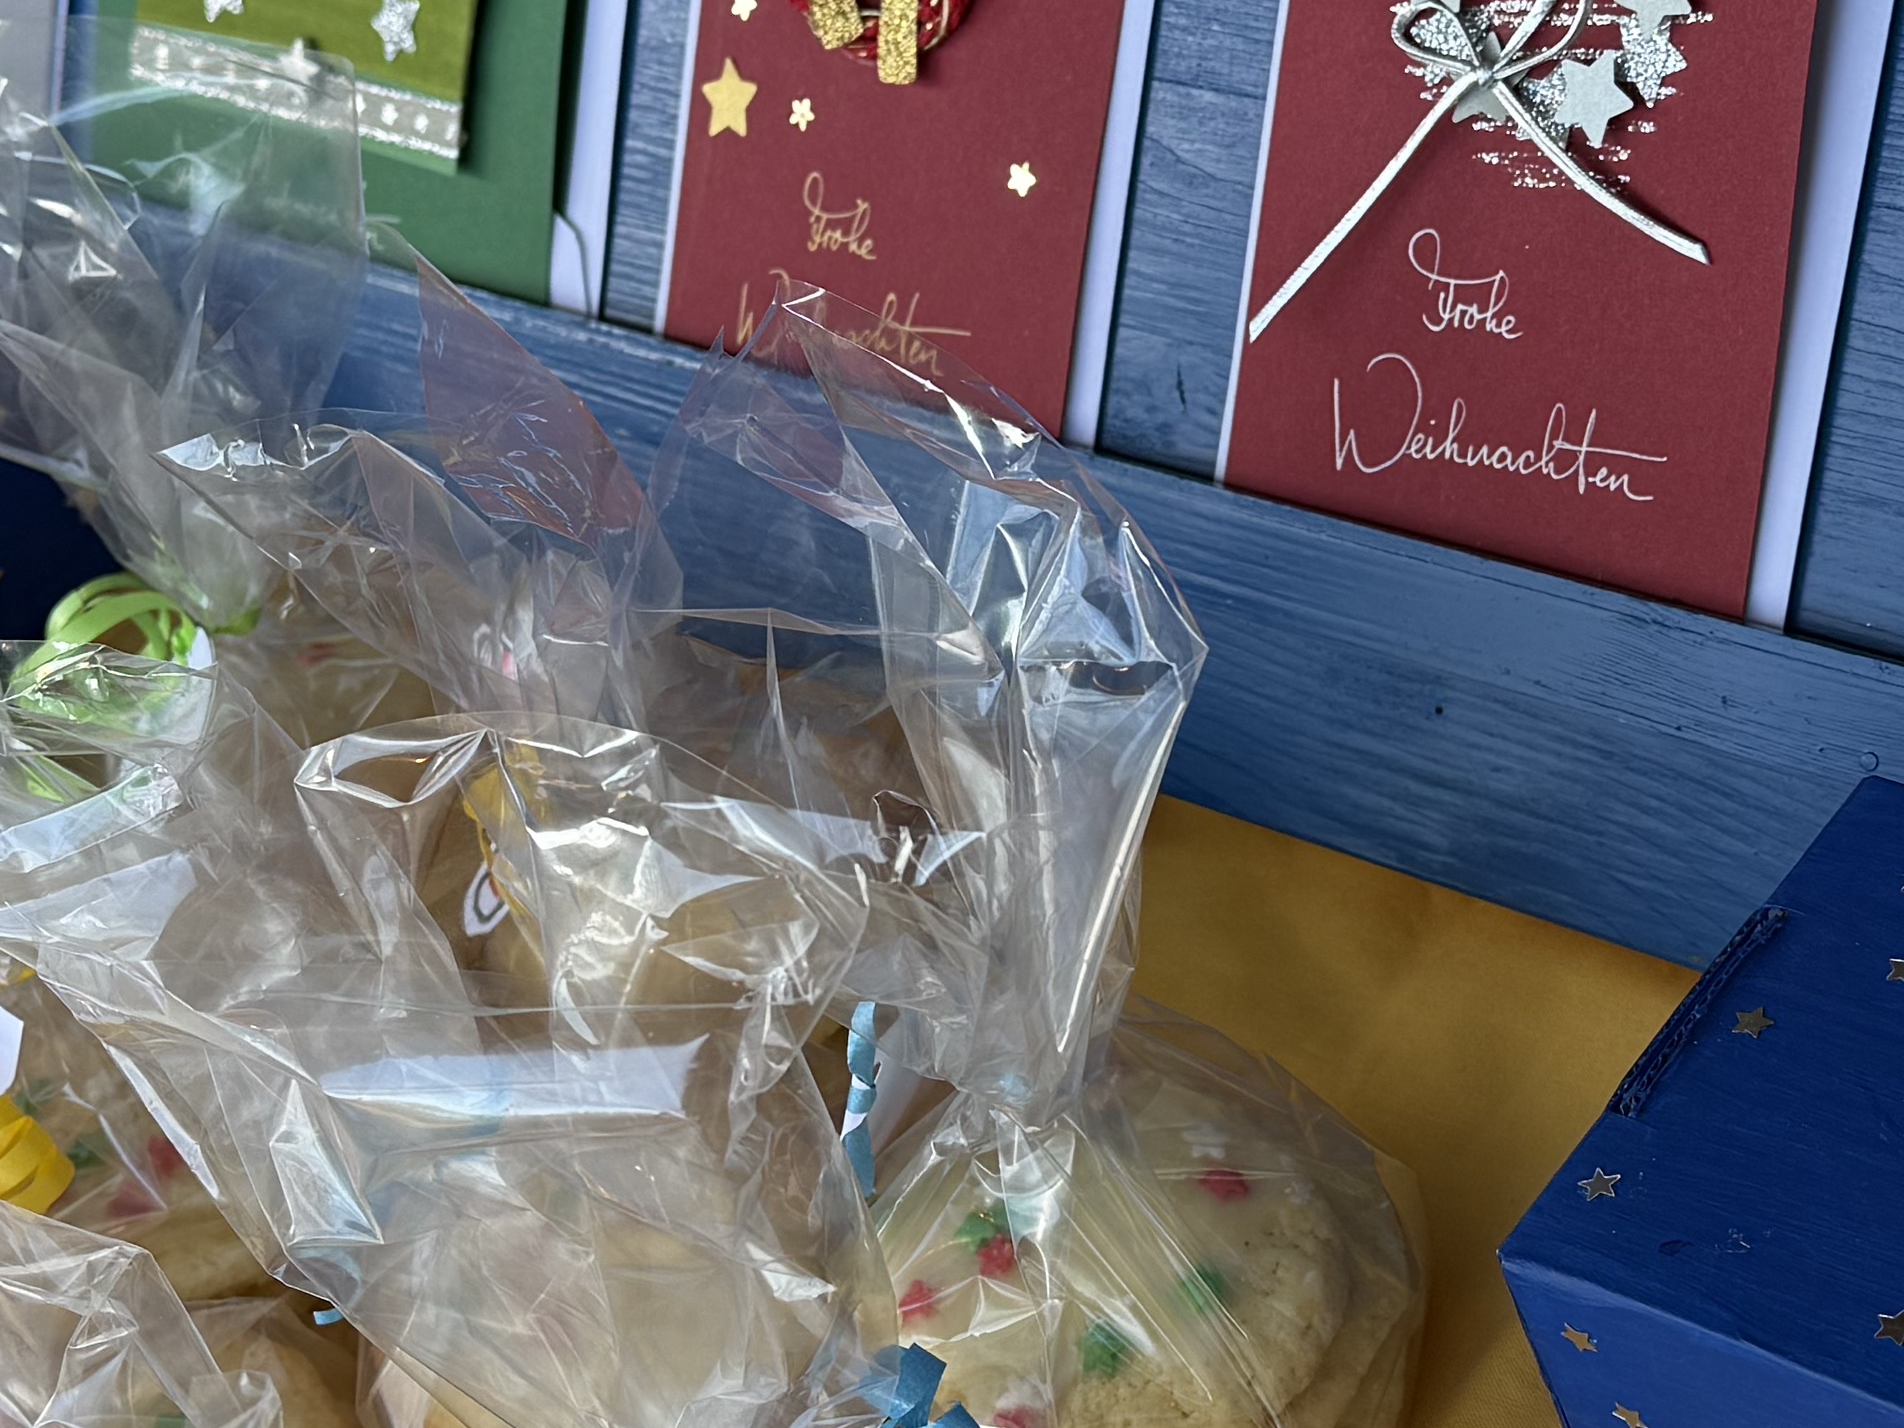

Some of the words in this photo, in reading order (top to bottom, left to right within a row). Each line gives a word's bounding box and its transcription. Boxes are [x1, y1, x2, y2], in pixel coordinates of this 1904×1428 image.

[803, 172, 876, 260] Frohe
[1407, 228, 1523, 340] Frohe
[1333, 353, 1667, 501] Weihnachten
